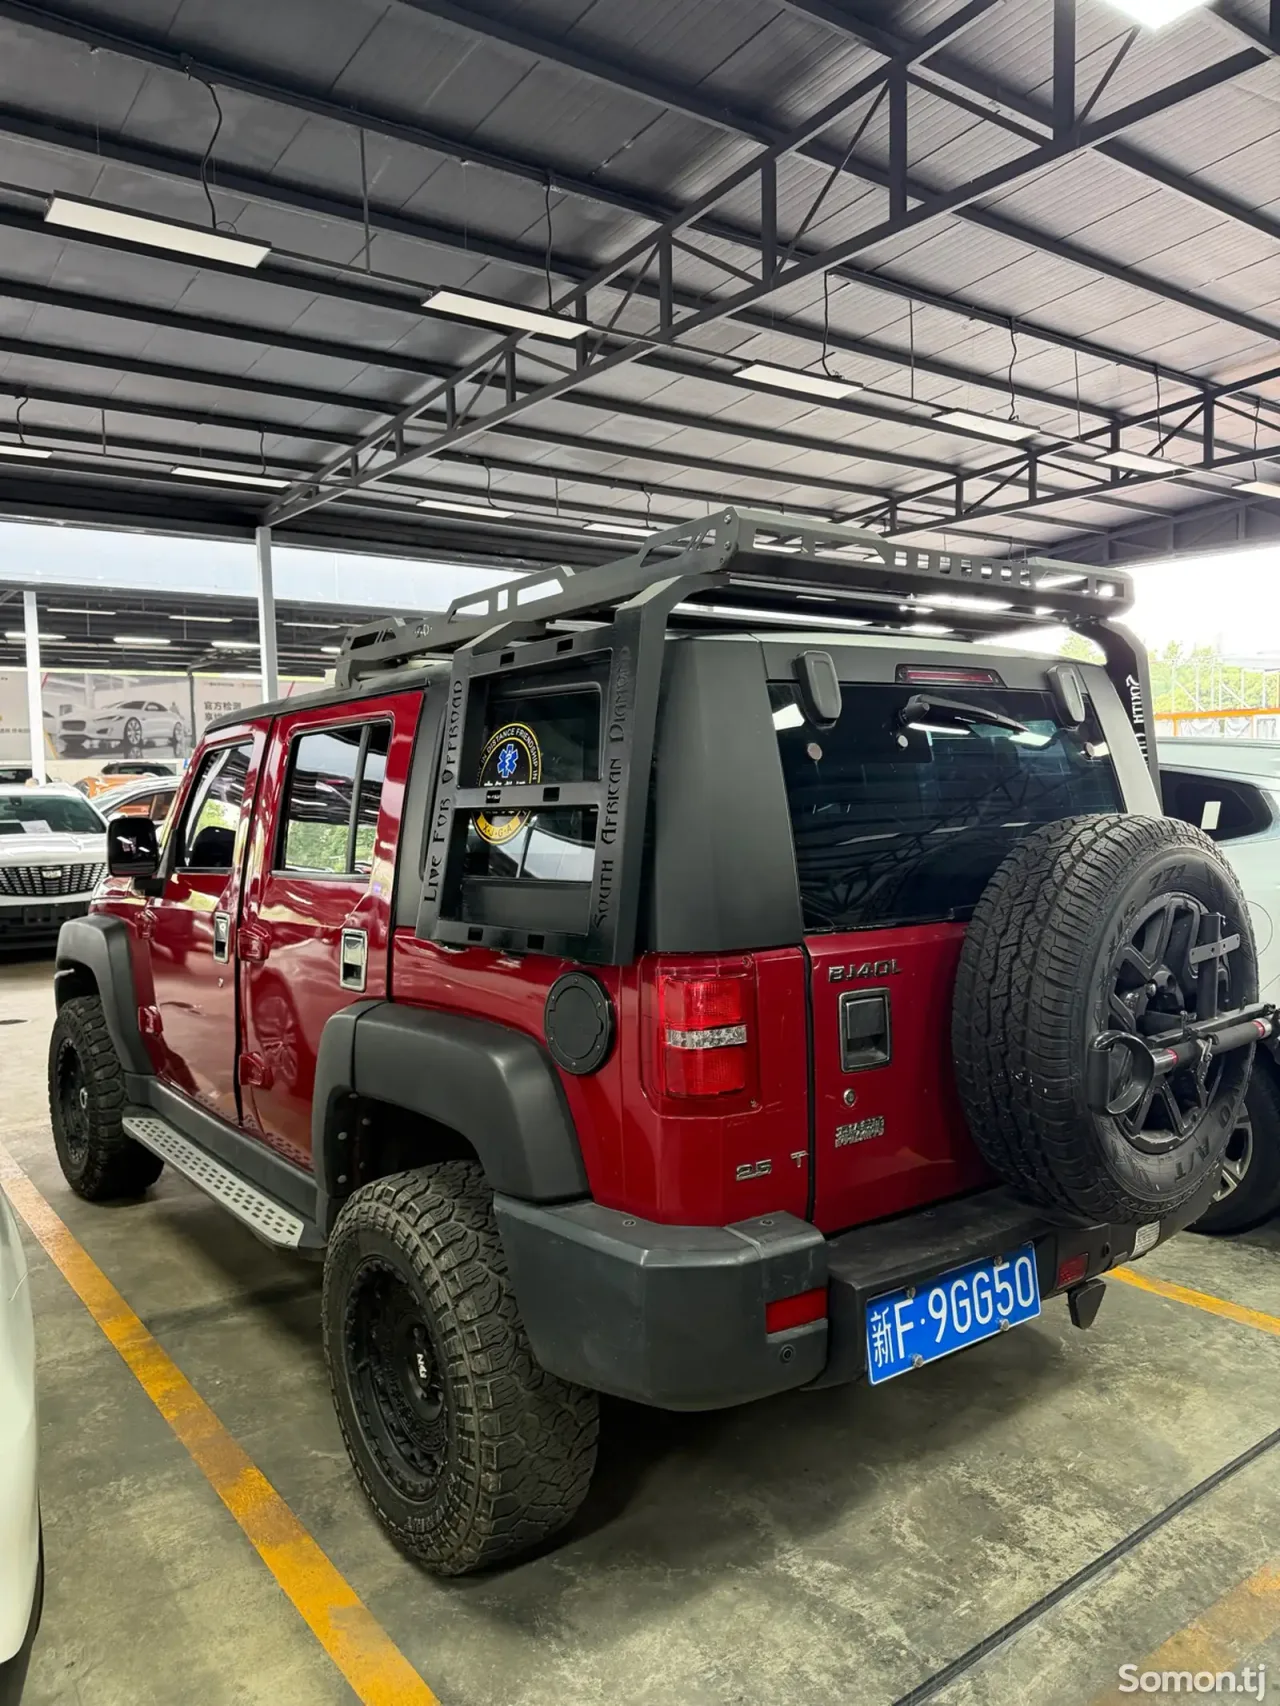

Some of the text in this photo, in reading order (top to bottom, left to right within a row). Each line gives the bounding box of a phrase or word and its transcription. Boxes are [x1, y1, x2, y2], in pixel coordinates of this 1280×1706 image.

[486, 728, 515, 754] DISTANCE
[515, 728, 538, 767] FRIENDSHIP
[828, 959, 903, 983] BJ40L
[790, 1150, 809, 1168] T
